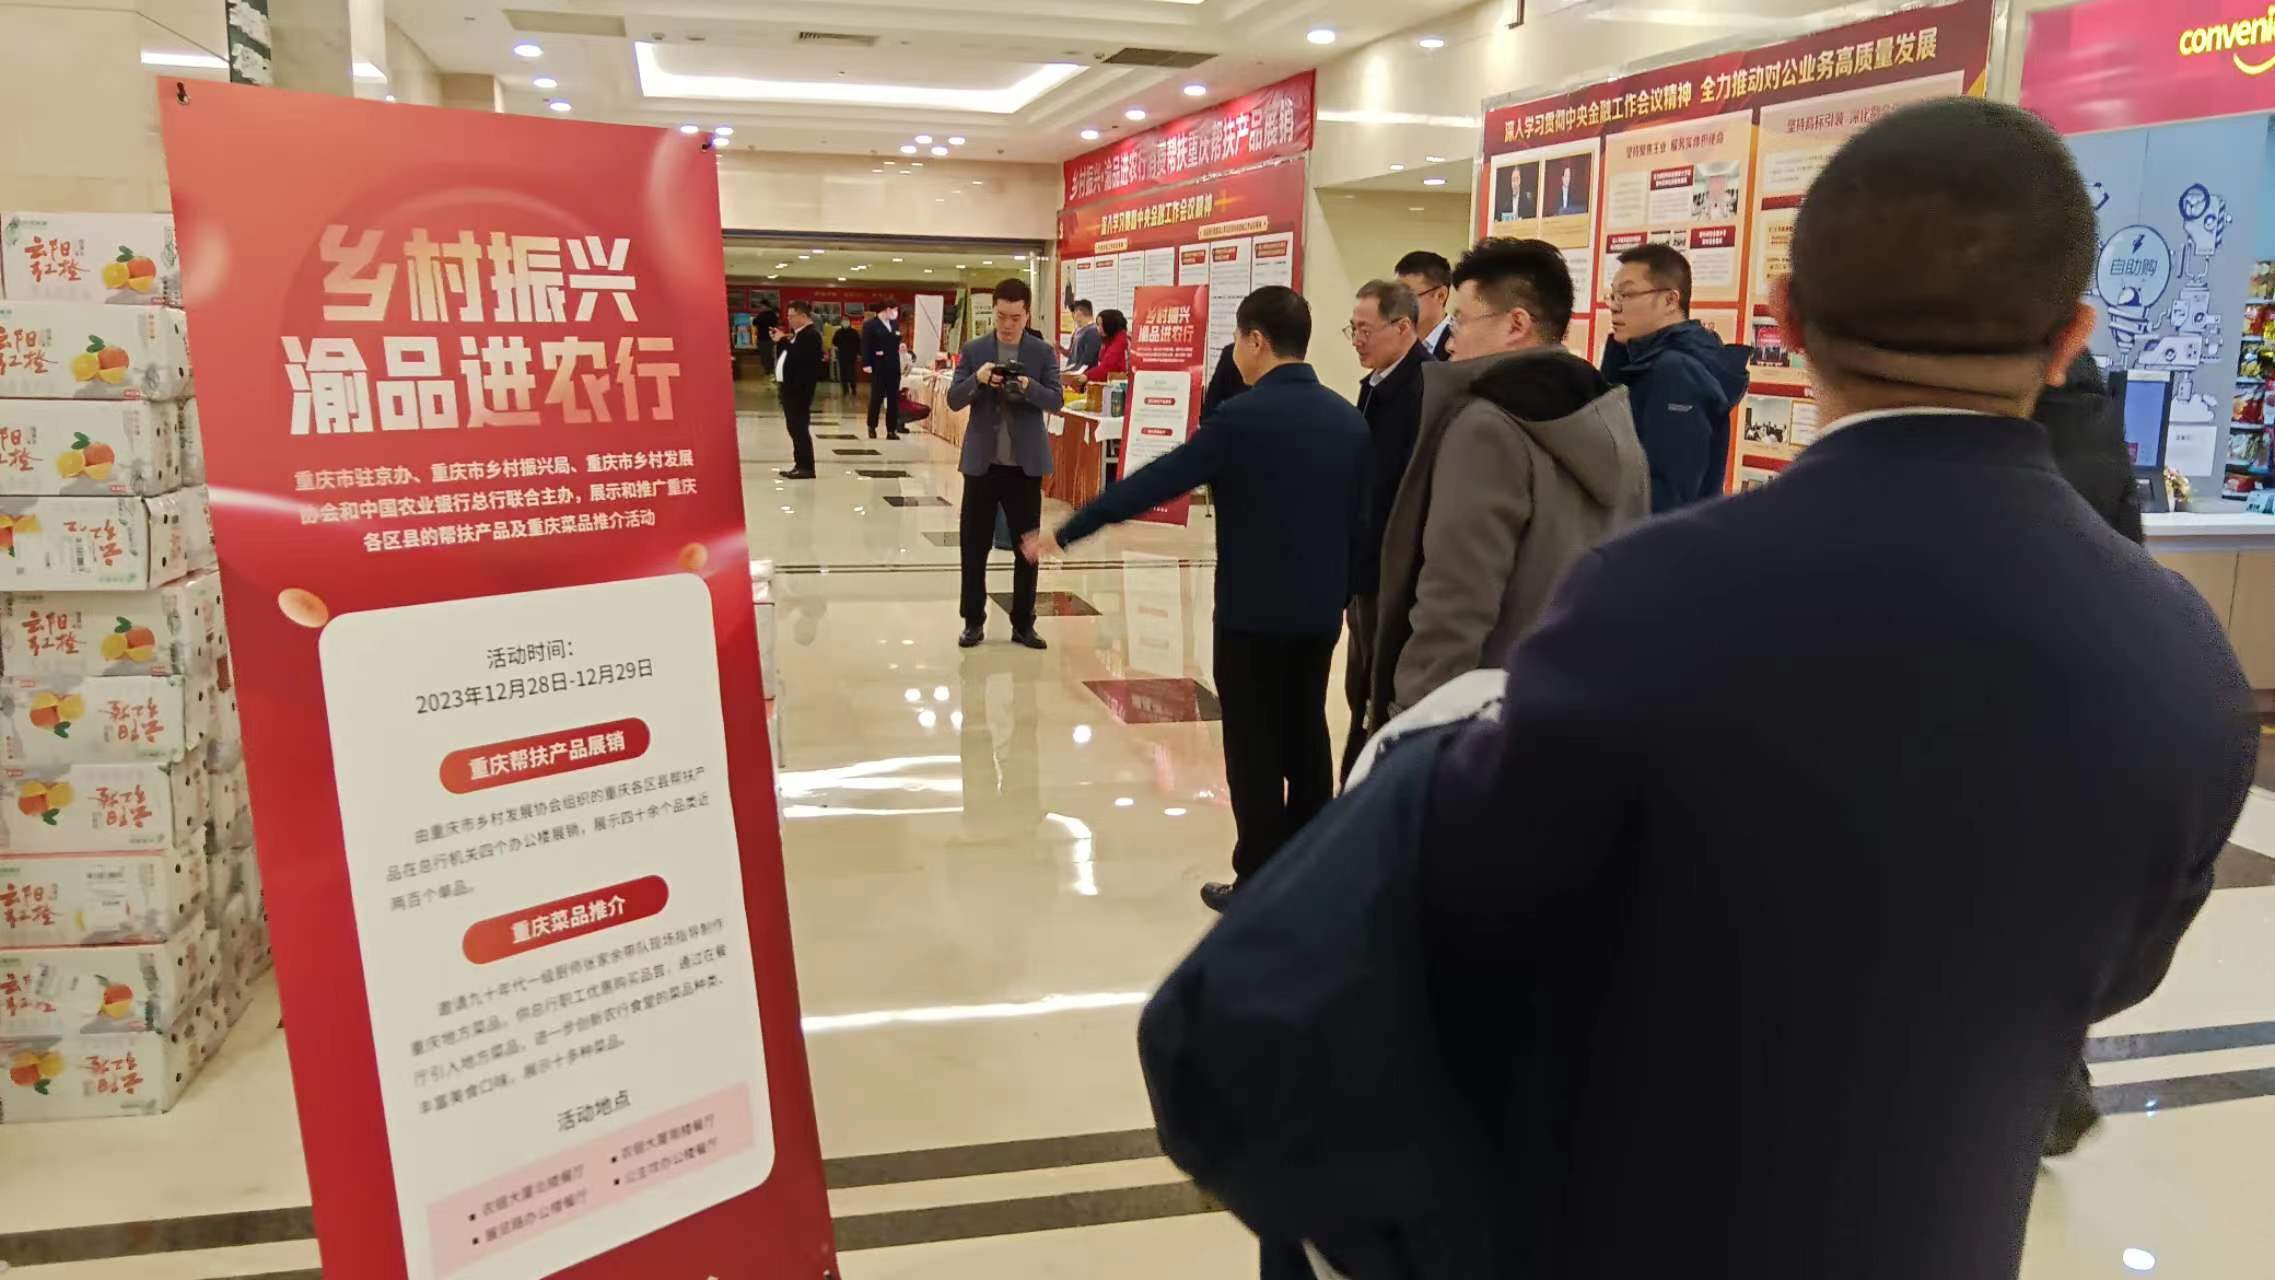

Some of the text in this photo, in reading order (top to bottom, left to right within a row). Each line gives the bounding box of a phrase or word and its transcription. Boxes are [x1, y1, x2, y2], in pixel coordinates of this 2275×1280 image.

[2179, 4, 2275, 56] conveni
[1504, 26, 1939, 143] 深入学习贯彻中央金融工作会议精神 全力推动对公业务高质量发展
[24, 235, 71, 262] 云阳
[2110, 257, 2159, 277] 自助购
[319, 223, 639, 324] 乡村振兴
[280, 335, 681, 436] 渝品进农行
[293, 449, 695, 492] 重庆市驻京办、重庆市乡村振兴局、重庆市乡村发展
[301, 477, 698, 525] 协会和中国农业银行总行联合主办，展示和推广重庆
[363, 509, 656, 553] 各区县的帮扶产品及重庆菜品推介活动
[486, 639, 575, 670] 活动时间：
[415, 658, 654, 715] 2023年12月28日-12月29日
[467, 730, 626, 781] 重庆帮扶产品展销
[511, 895, 626, 945] 重庆菜品推介
[556, 1089, 632, 1133] 活动地点
